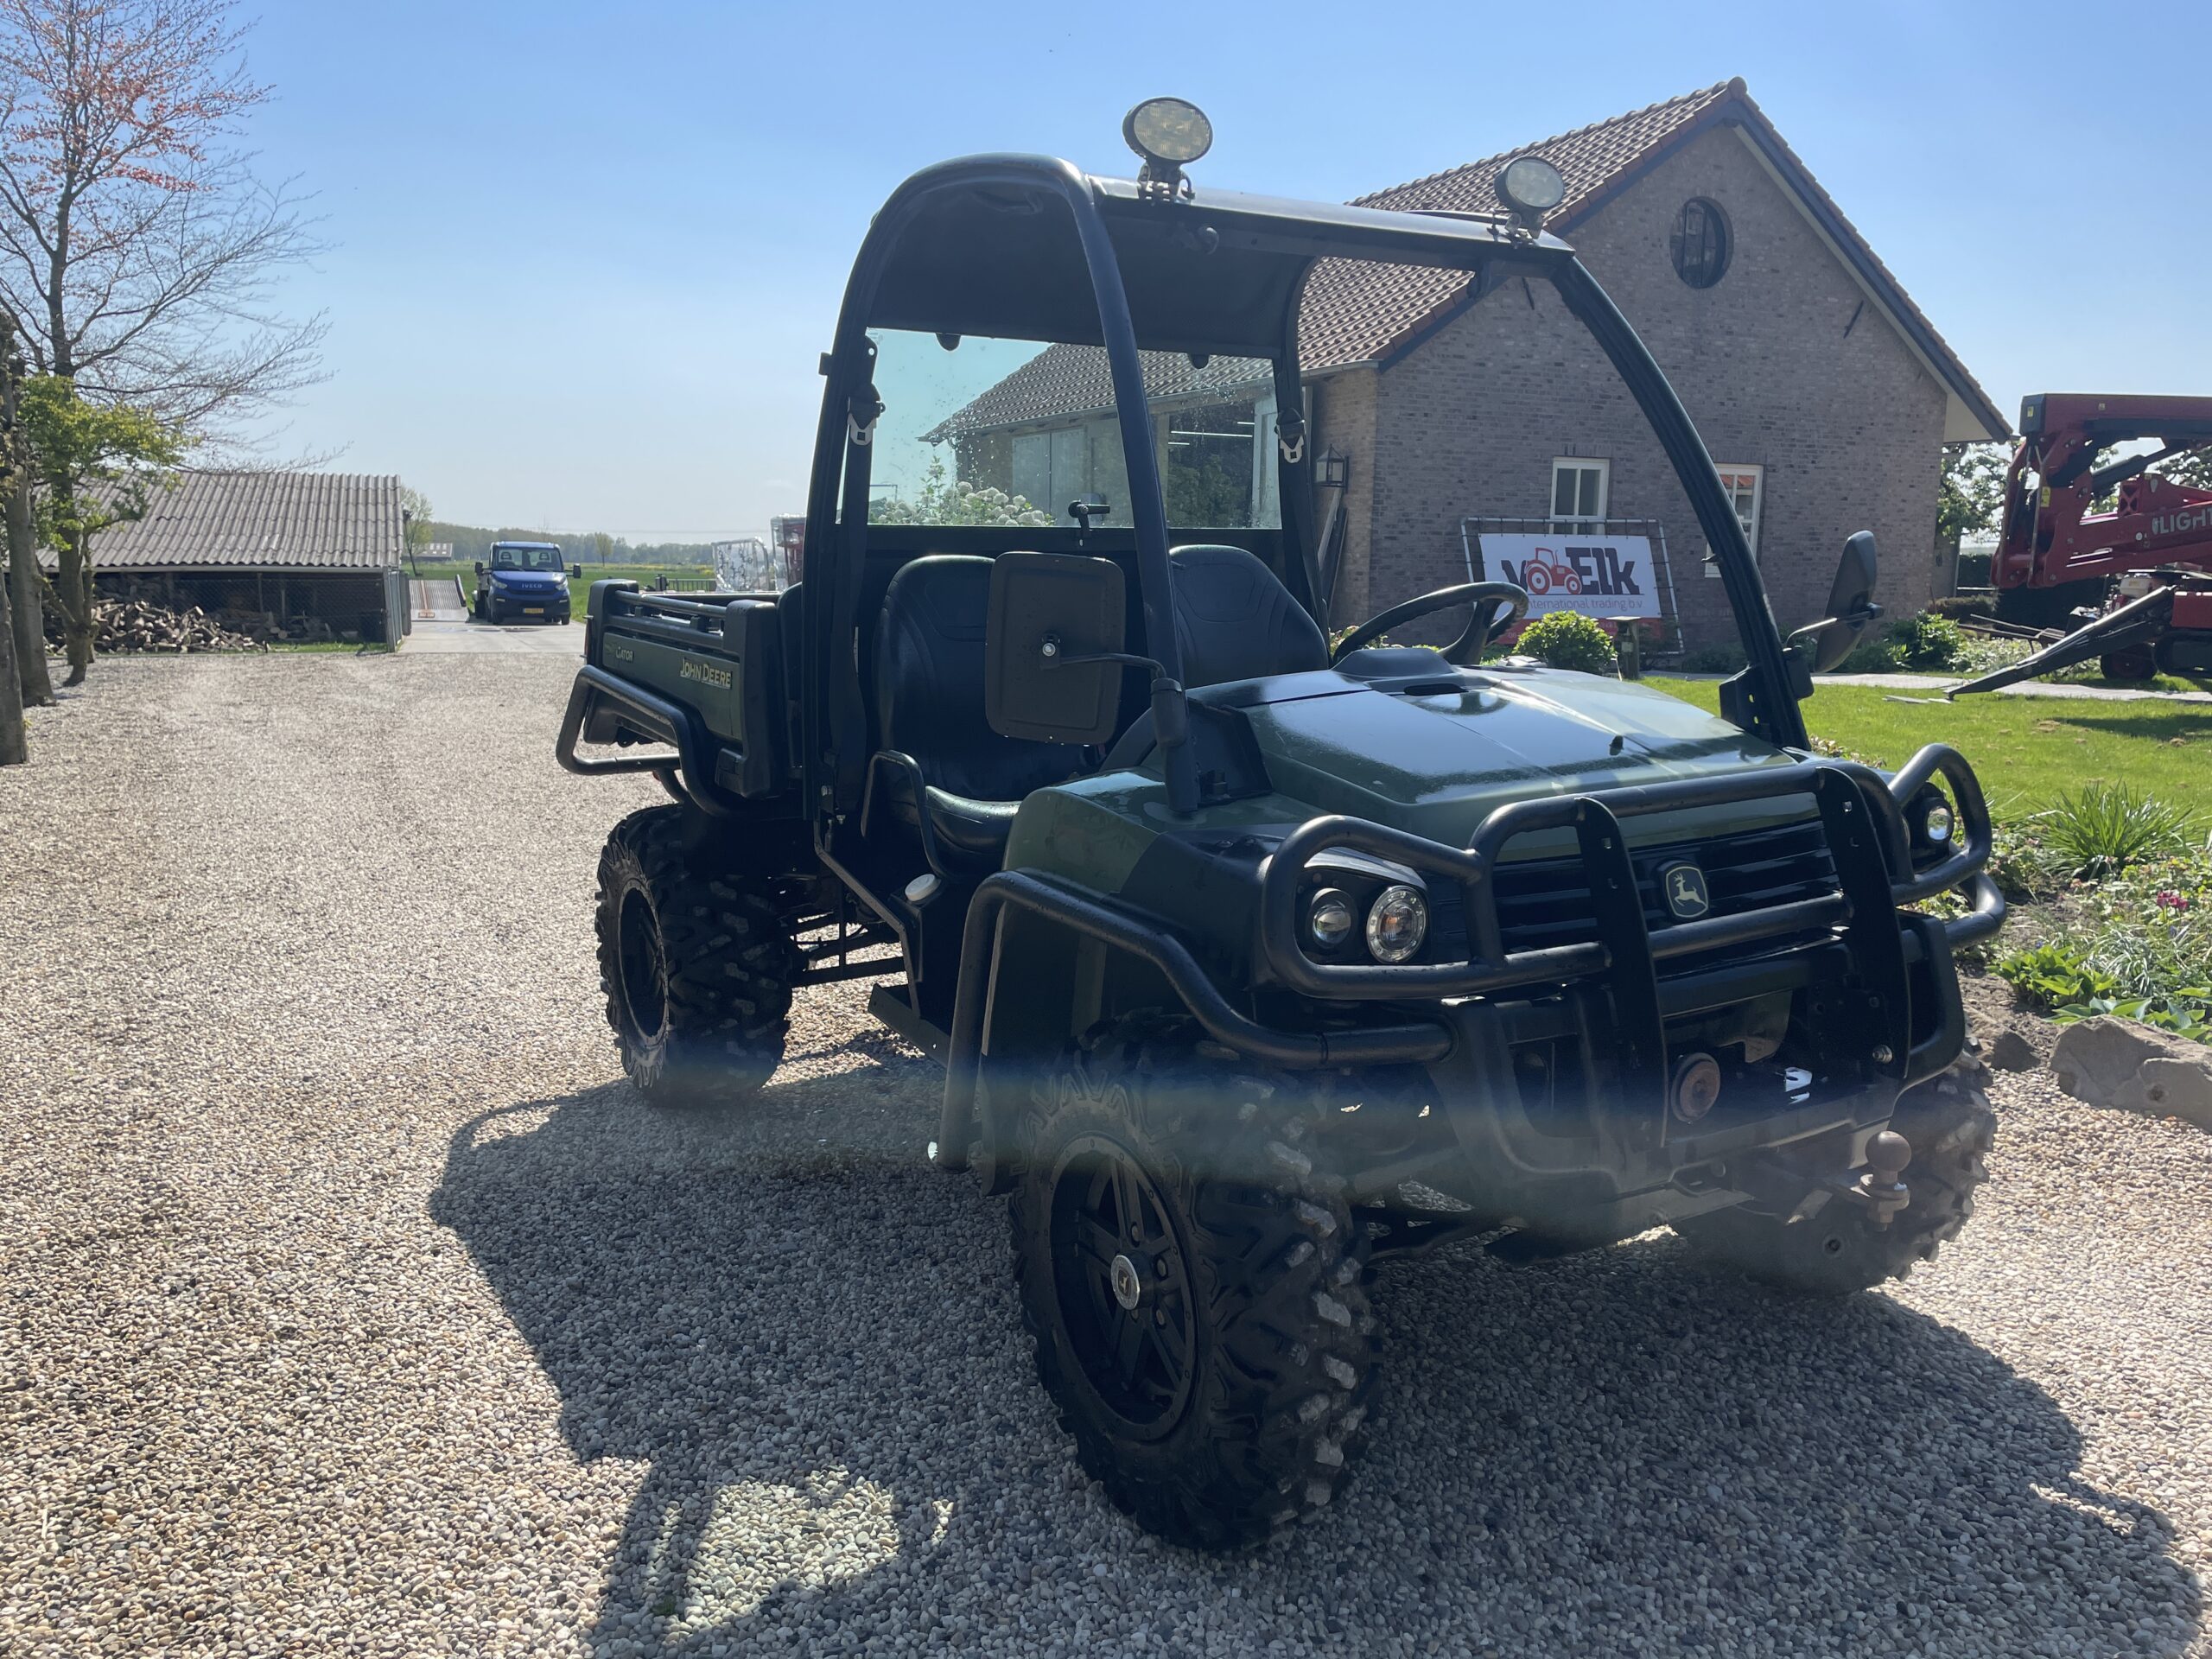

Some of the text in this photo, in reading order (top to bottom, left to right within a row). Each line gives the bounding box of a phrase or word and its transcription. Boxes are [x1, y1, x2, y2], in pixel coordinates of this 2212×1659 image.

[1565, 547, 1640, 595] Elk
[1528, 597, 1588, 609] nternational
[1591, 597, 1628, 611] trading
[616, 646, 633, 662] GATOR
[680, 658, 732, 689] JOHN DEERE
